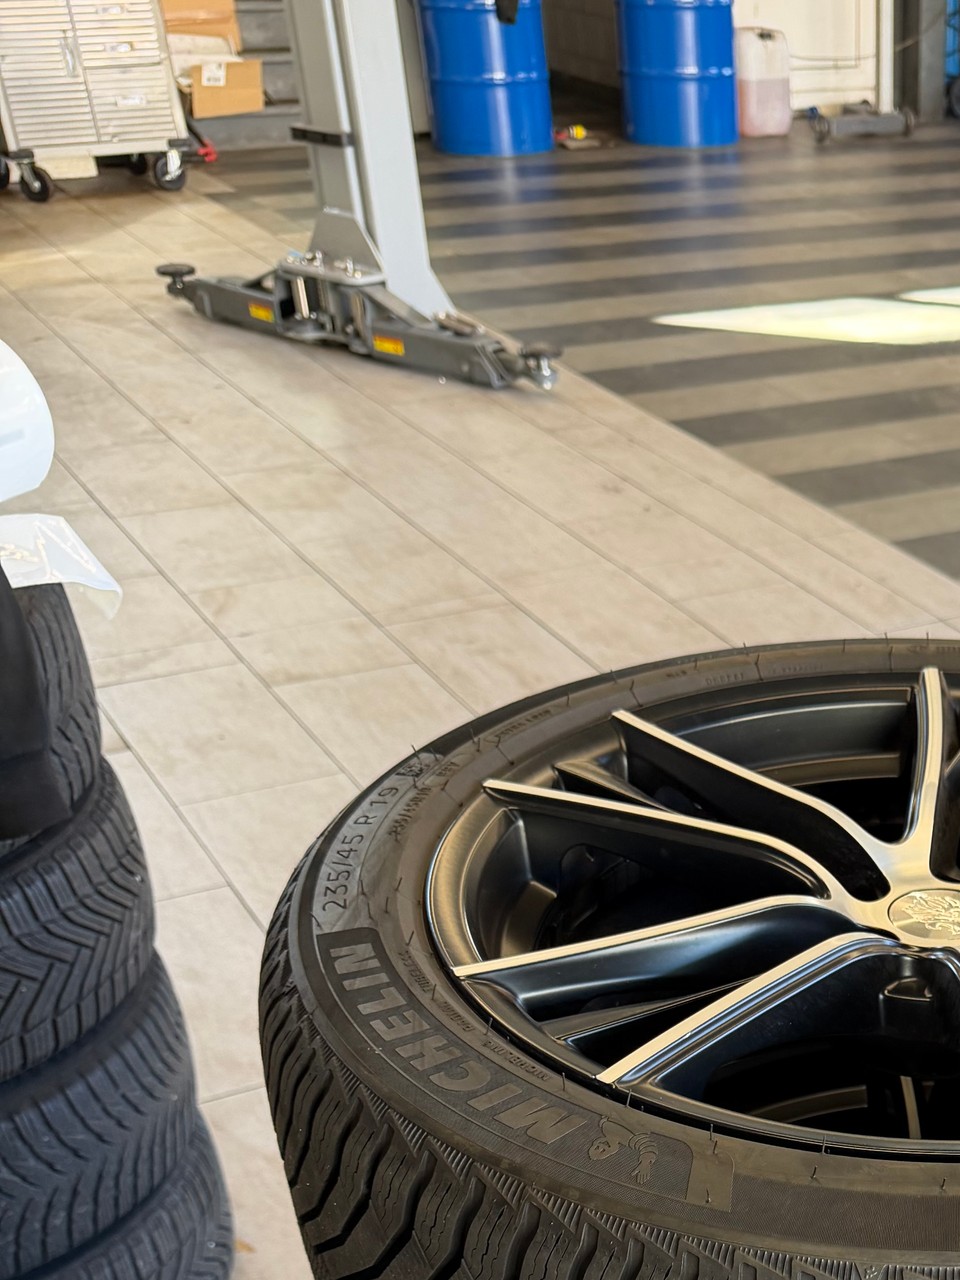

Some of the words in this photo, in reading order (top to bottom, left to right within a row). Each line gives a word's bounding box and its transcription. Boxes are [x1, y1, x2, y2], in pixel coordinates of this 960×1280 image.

[322, 833, 365, 912] 235/45
[353, 814, 378, 826] R
[369, 786, 399, 806] 19
[329, 942, 588, 1145] MICHELIN
